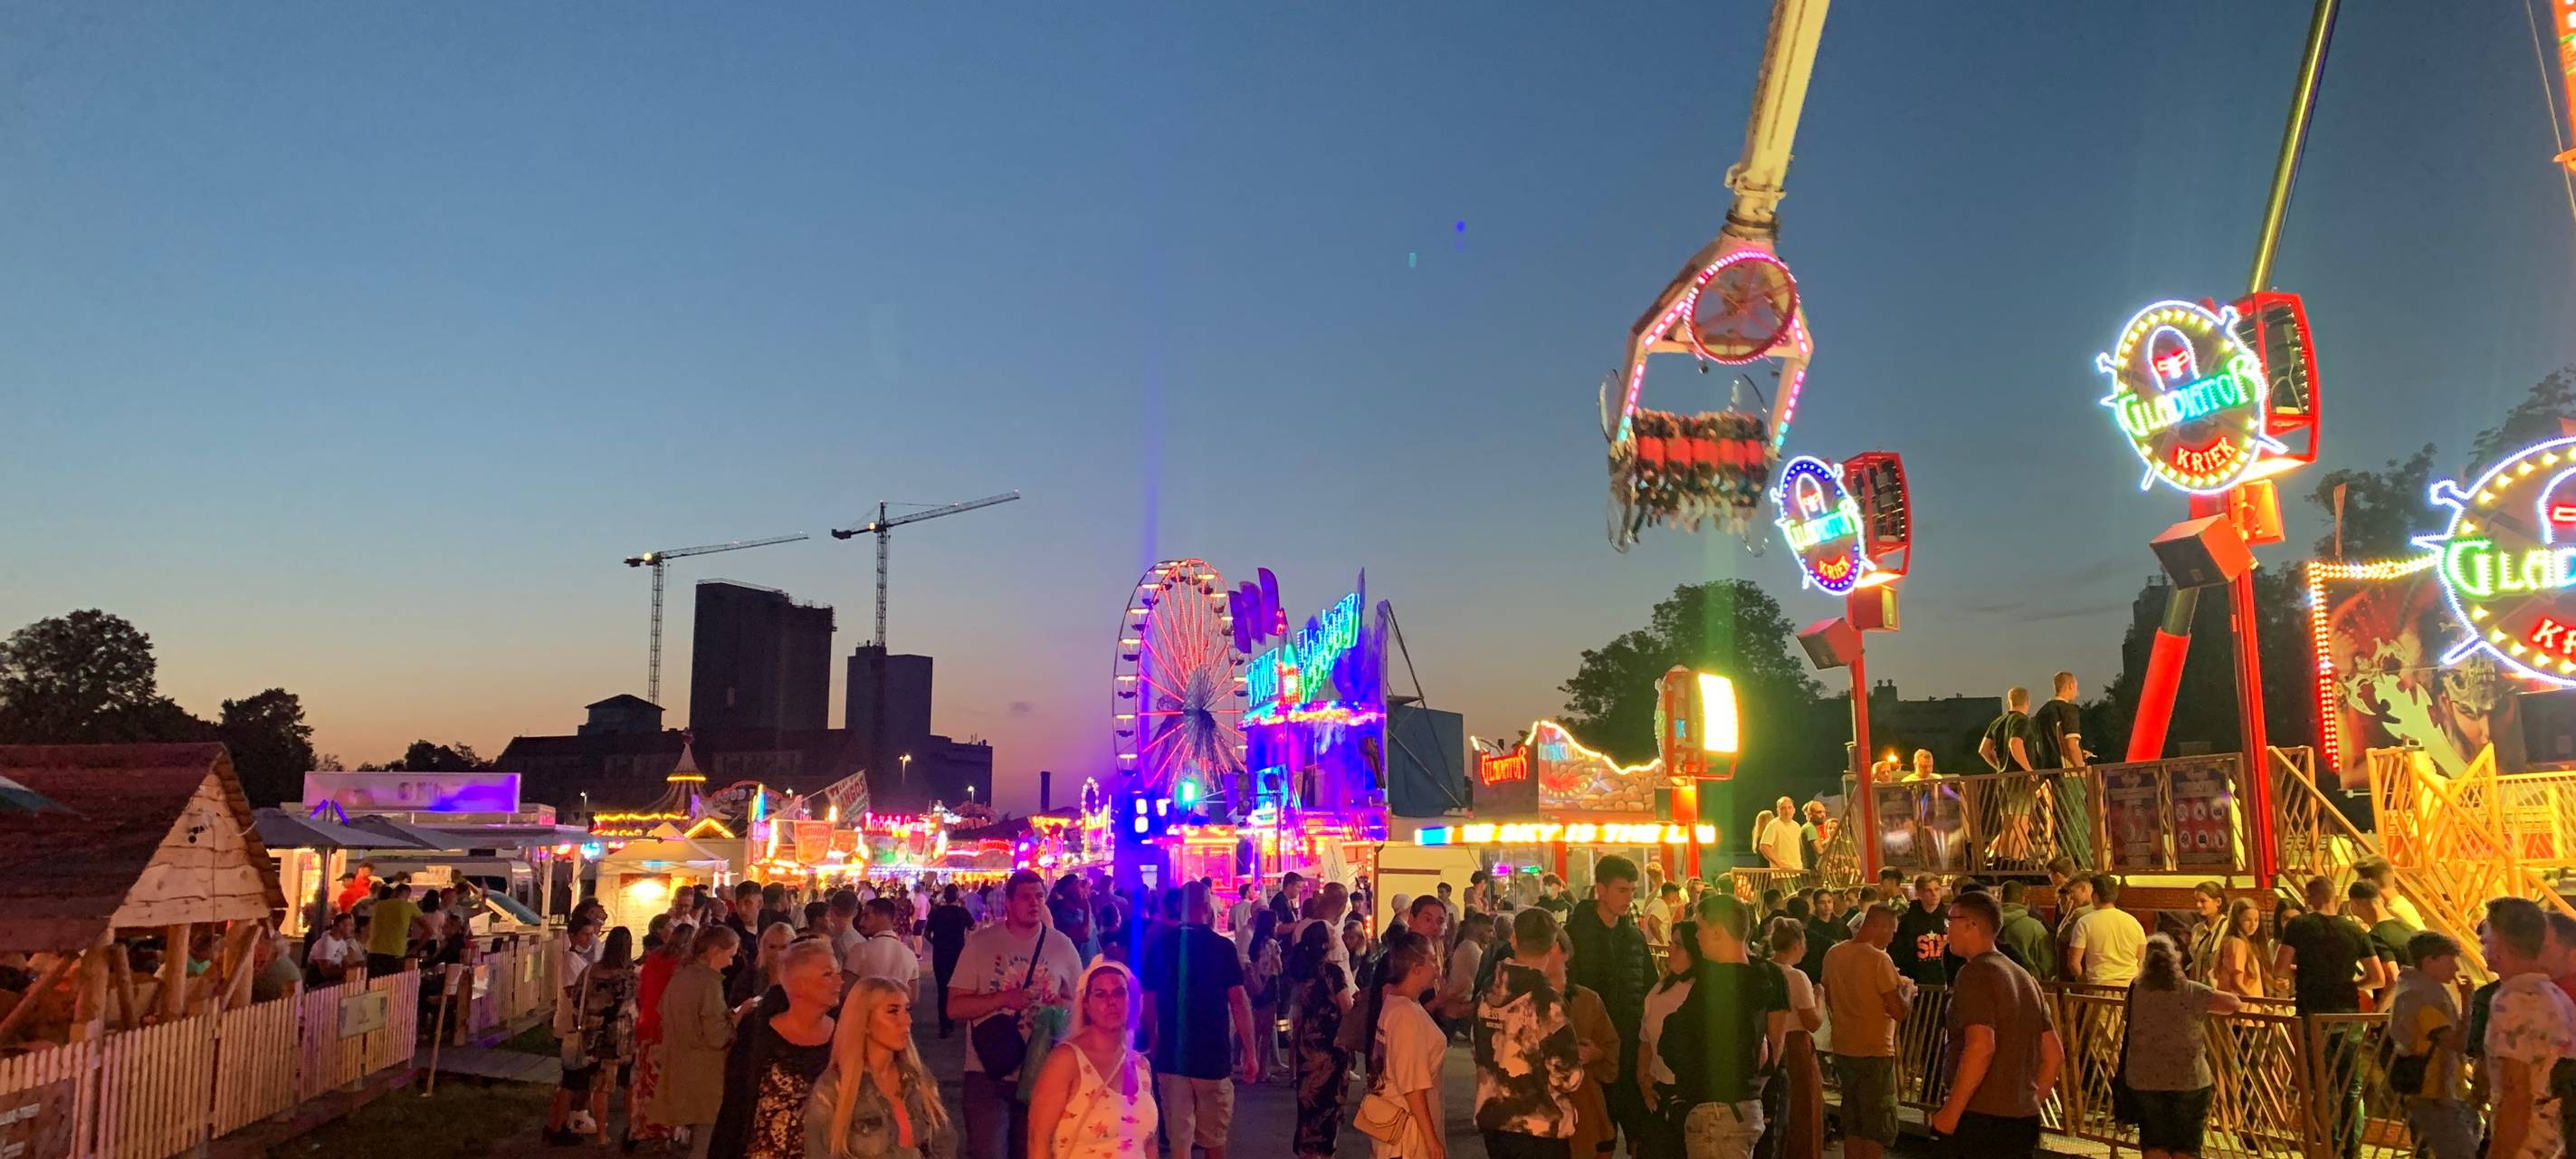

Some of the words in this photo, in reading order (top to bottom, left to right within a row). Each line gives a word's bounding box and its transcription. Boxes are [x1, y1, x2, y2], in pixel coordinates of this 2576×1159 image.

[2118, 354, 2263, 436] GLADIATOR
[2176, 436, 2236, 473] KRIEK
[1819, 556, 1851, 580] KRIEK
